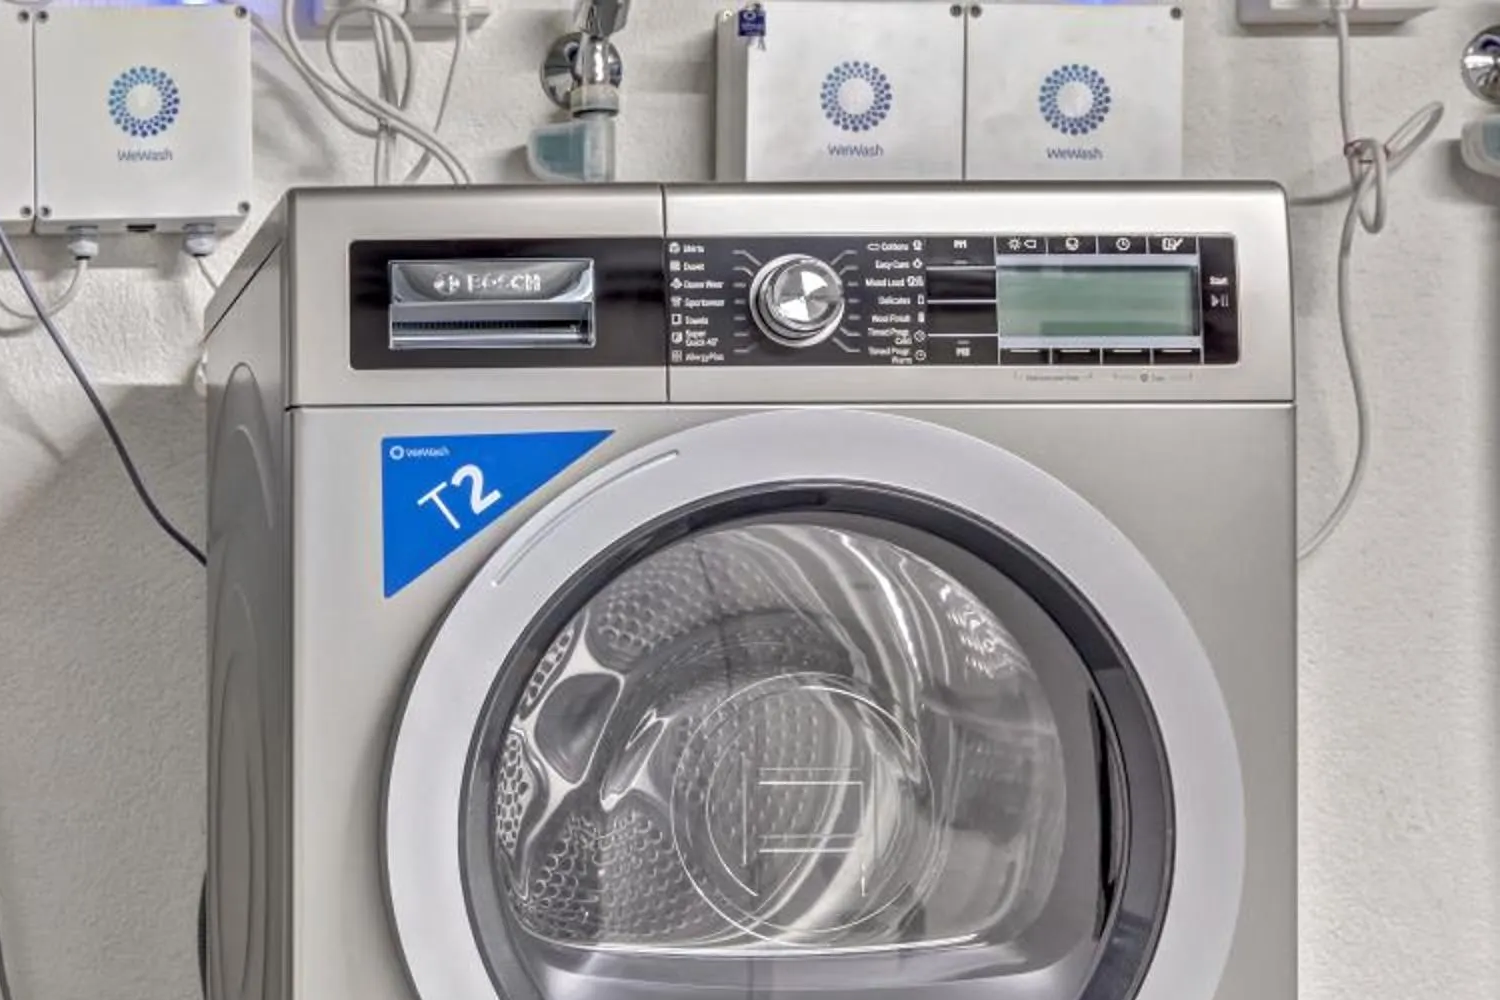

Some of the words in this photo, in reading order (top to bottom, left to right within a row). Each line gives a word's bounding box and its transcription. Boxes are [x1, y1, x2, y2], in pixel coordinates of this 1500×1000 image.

[117, 148, 173, 163] WeWash
[828, 143, 884, 158] WeWash
[1047, 147, 1103, 161] WeWash
[416, 463, 502, 530] T2
